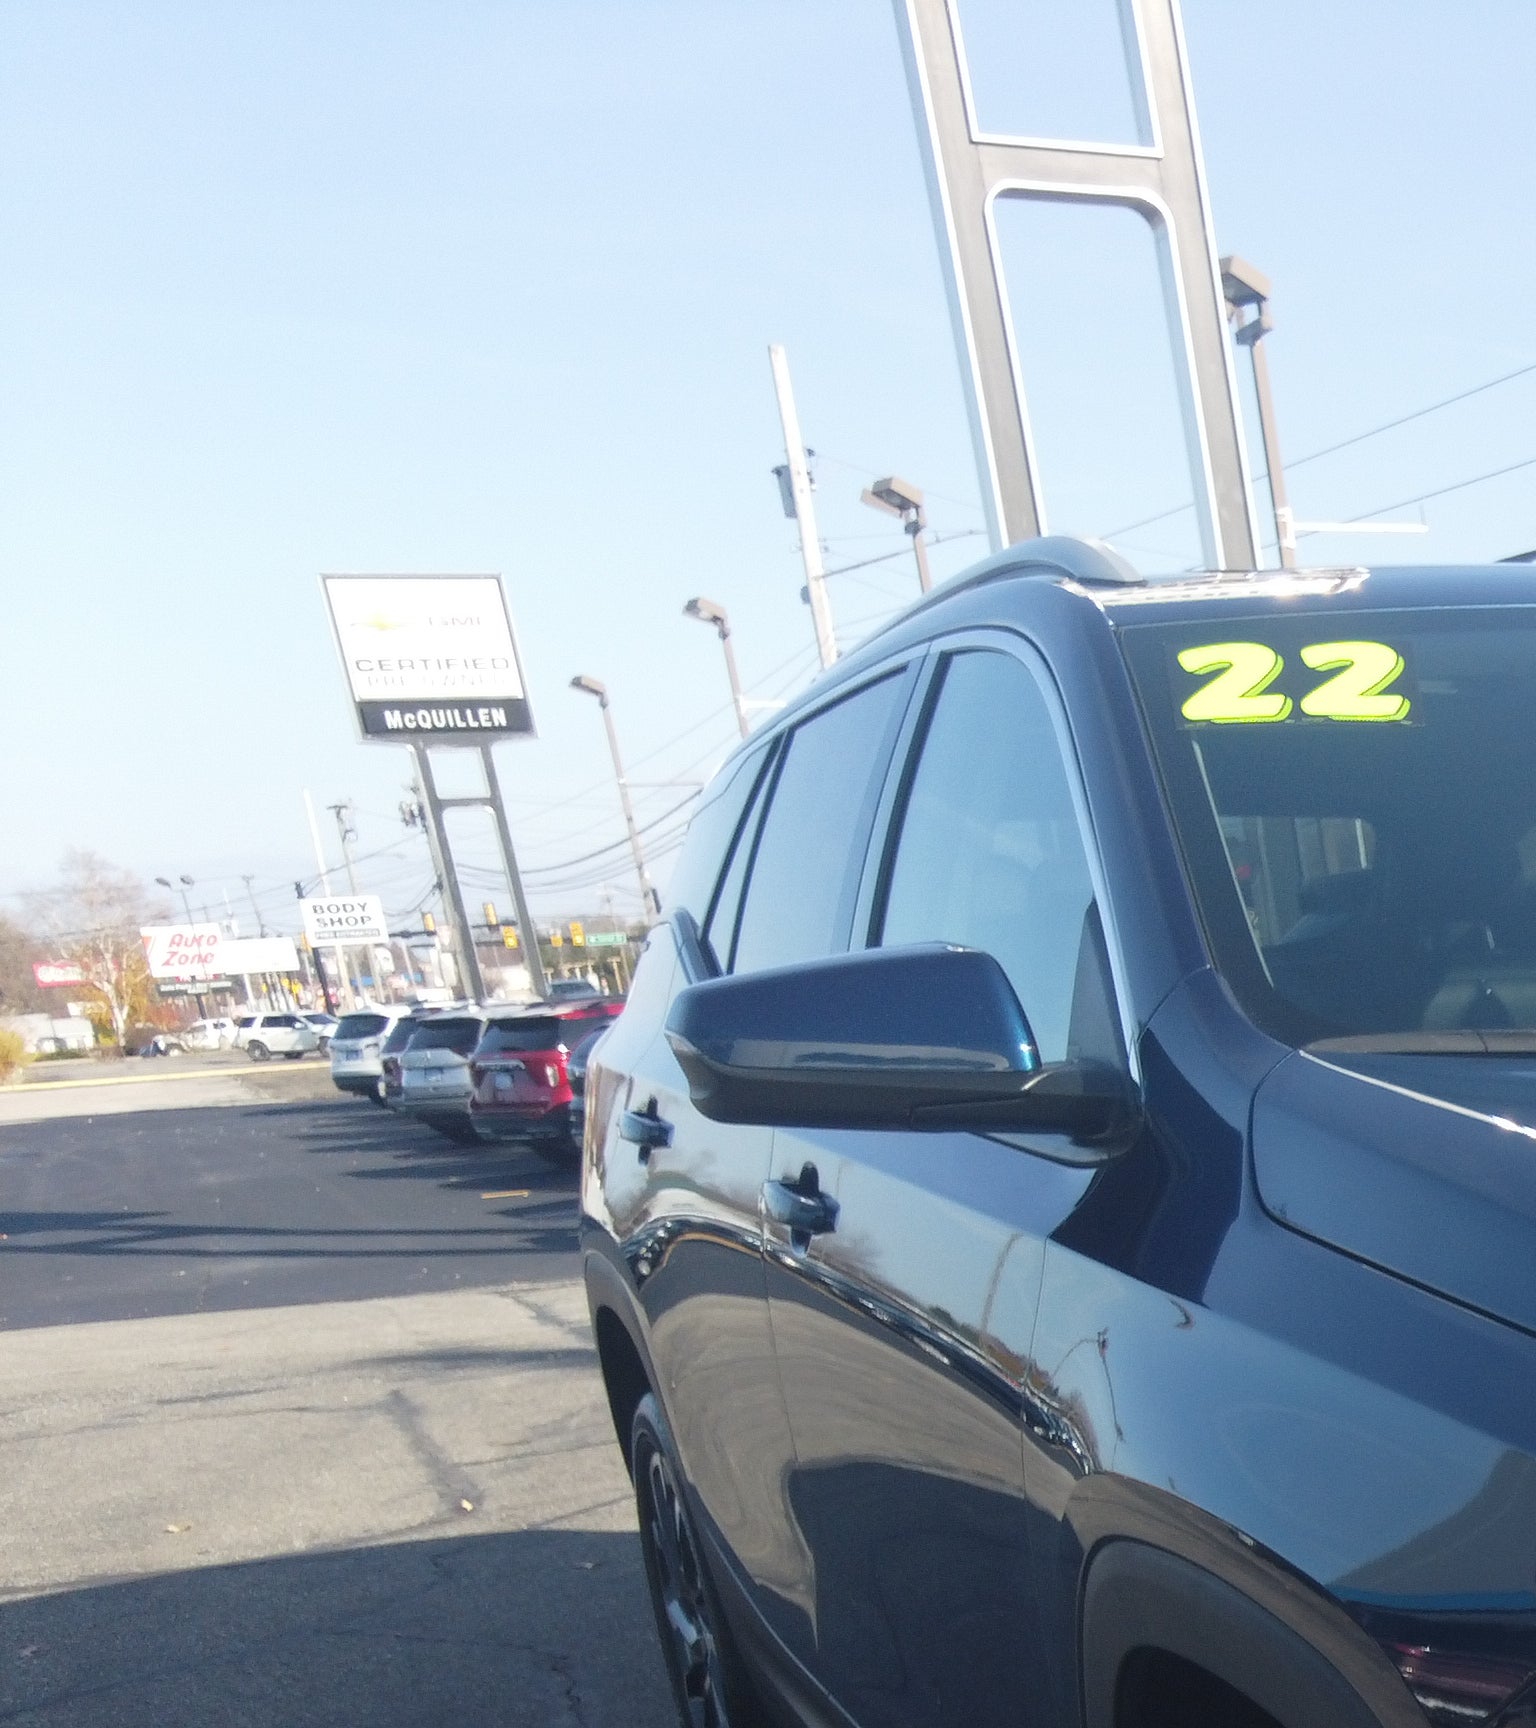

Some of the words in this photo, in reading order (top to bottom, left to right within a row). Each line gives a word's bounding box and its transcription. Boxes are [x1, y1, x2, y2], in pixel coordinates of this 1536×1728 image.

[355, 658, 510, 673] CERTIFIED
[1177, 641, 1412, 724] 22
[383, 707, 508, 730] McQUILLEN
[312, 902, 367, 914] BODY
[316, 915, 372, 927] SHOP
